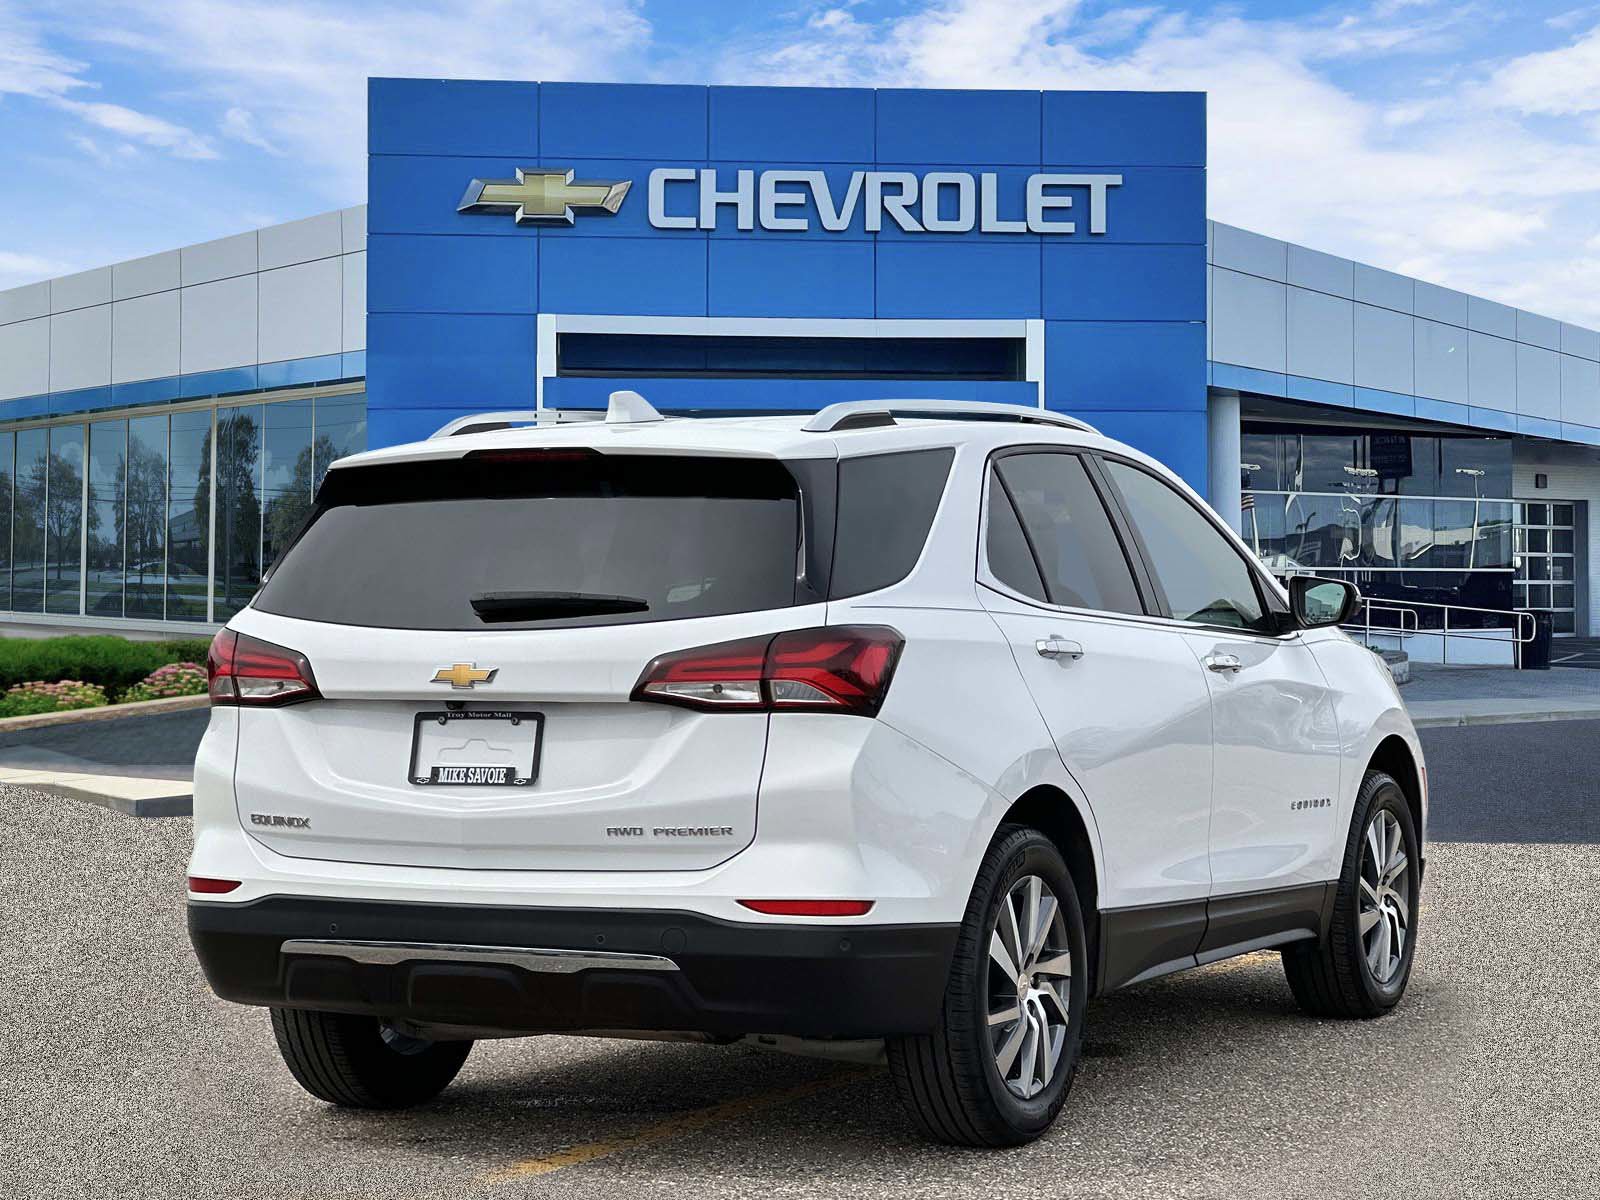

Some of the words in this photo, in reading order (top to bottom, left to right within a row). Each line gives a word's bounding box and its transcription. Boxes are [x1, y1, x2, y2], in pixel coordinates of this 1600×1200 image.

[648, 168, 1123, 234] CHEVROLET
[438, 767, 467, 783] MIKE
[467, 767, 506, 784] SAVOIE
[250, 813, 312, 829] EQUINOX
[606, 826, 643, 837] AWD
[653, 826, 734, 837] PREMIER
